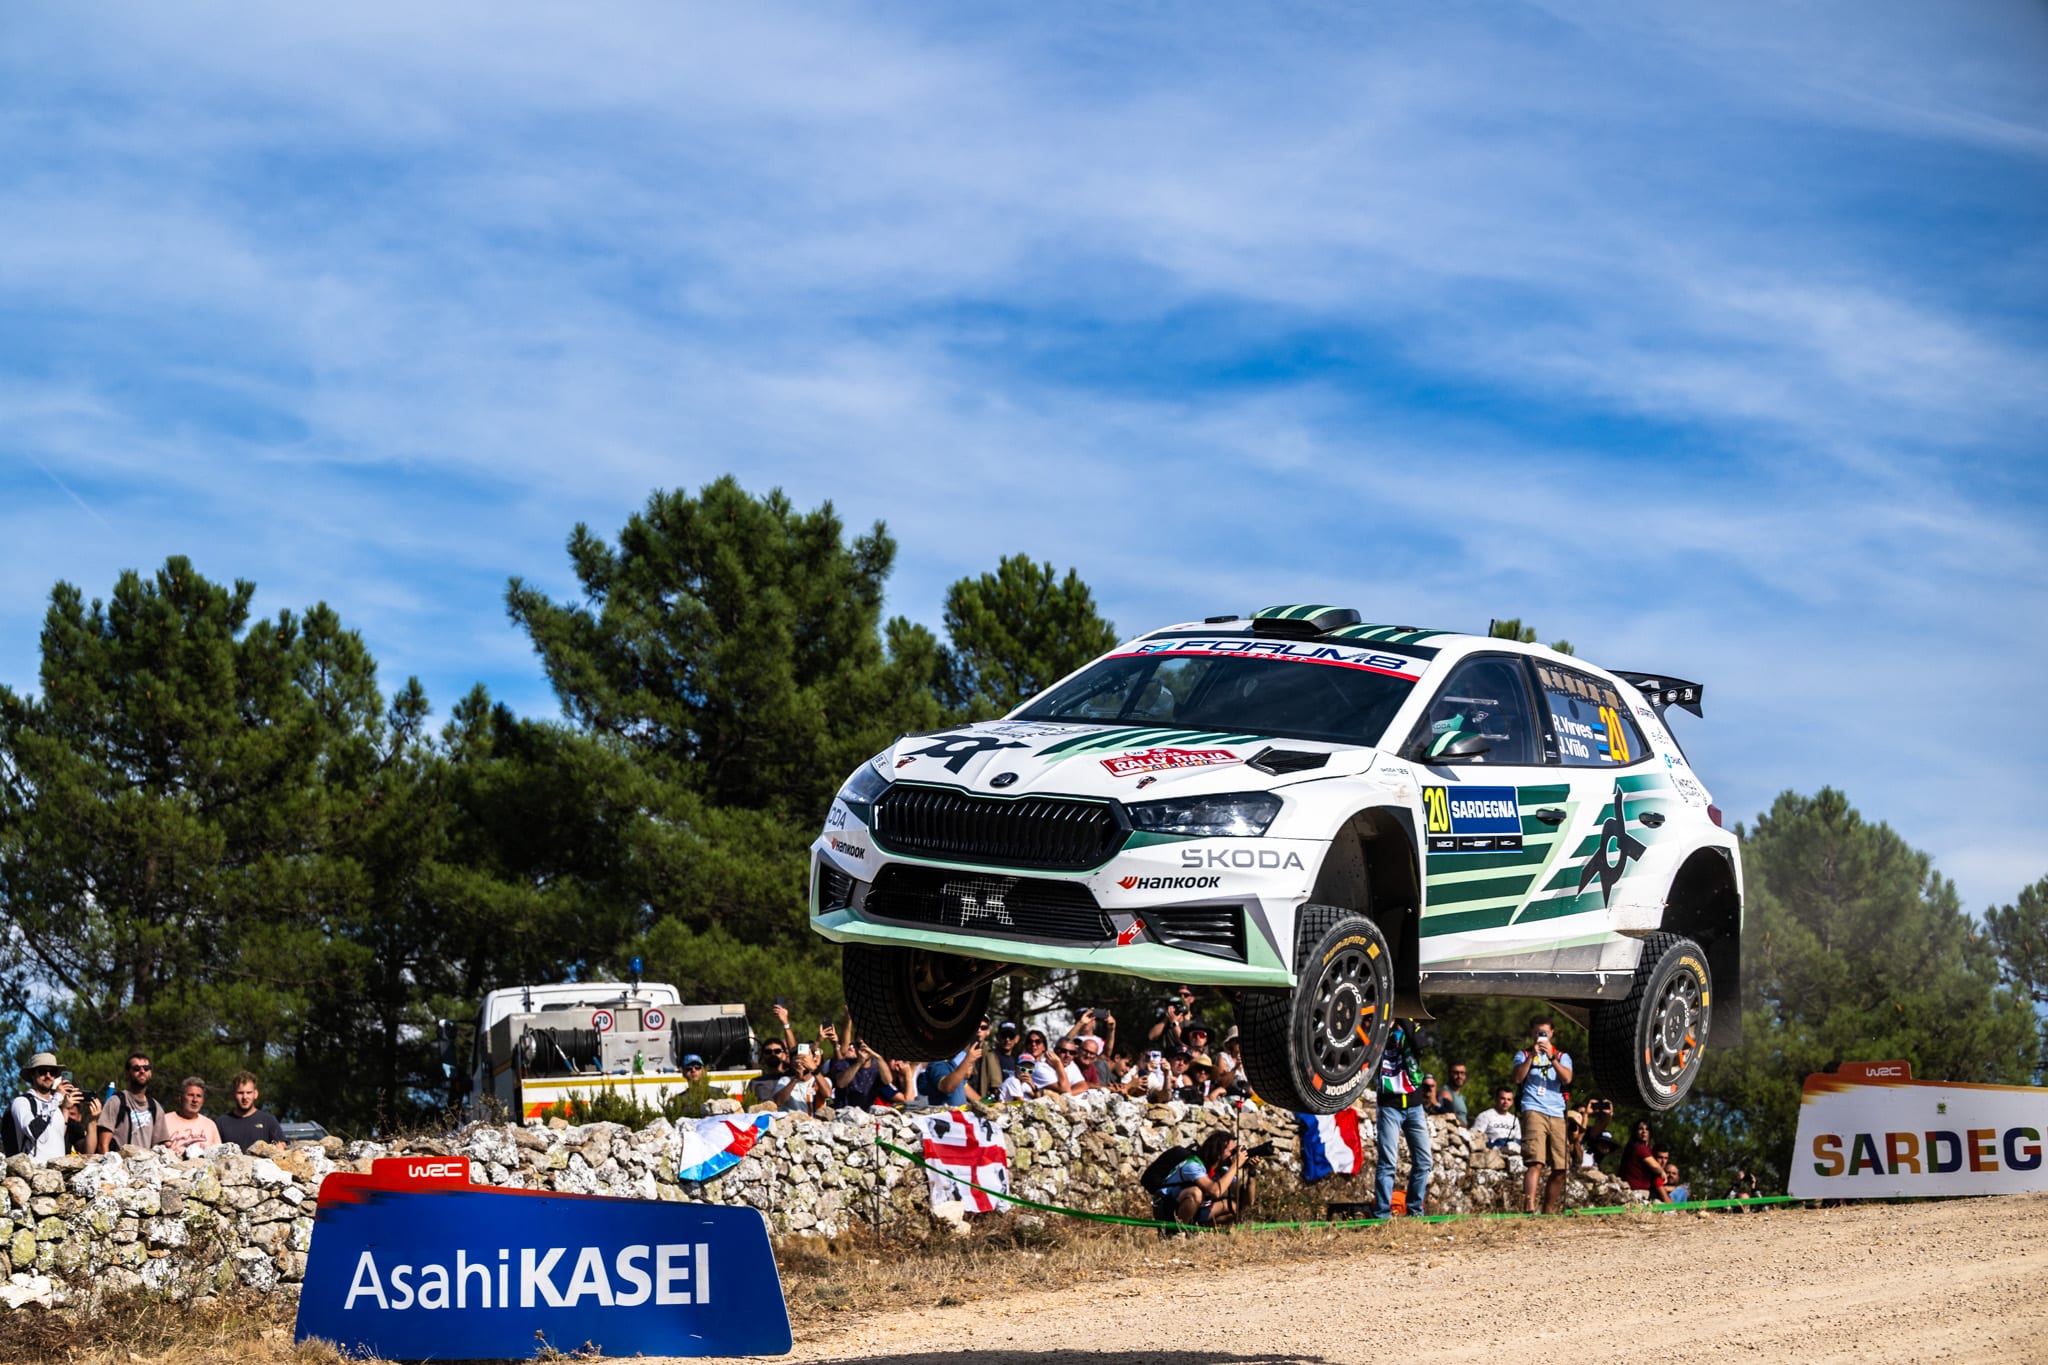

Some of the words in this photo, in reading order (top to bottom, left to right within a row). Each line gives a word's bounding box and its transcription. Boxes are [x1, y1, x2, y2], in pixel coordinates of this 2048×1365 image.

[1598, 705, 1630, 764] 20
[1114, 757, 1168, 771] RALLY
[1175, 753, 1229, 765] ITALIA
[1424, 787, 1449, 832] 20
[1452, 800, 1517, 819] SARDEGNA
[597, 1015, 608, 1025] 70
[648, 1014, 660, 1024] 80
[1866, 1066, 1902, 1077] WRC
[1813, 1126, 2048, 1177] SARDEG
[408, 1162, 463, 1179] WRC
